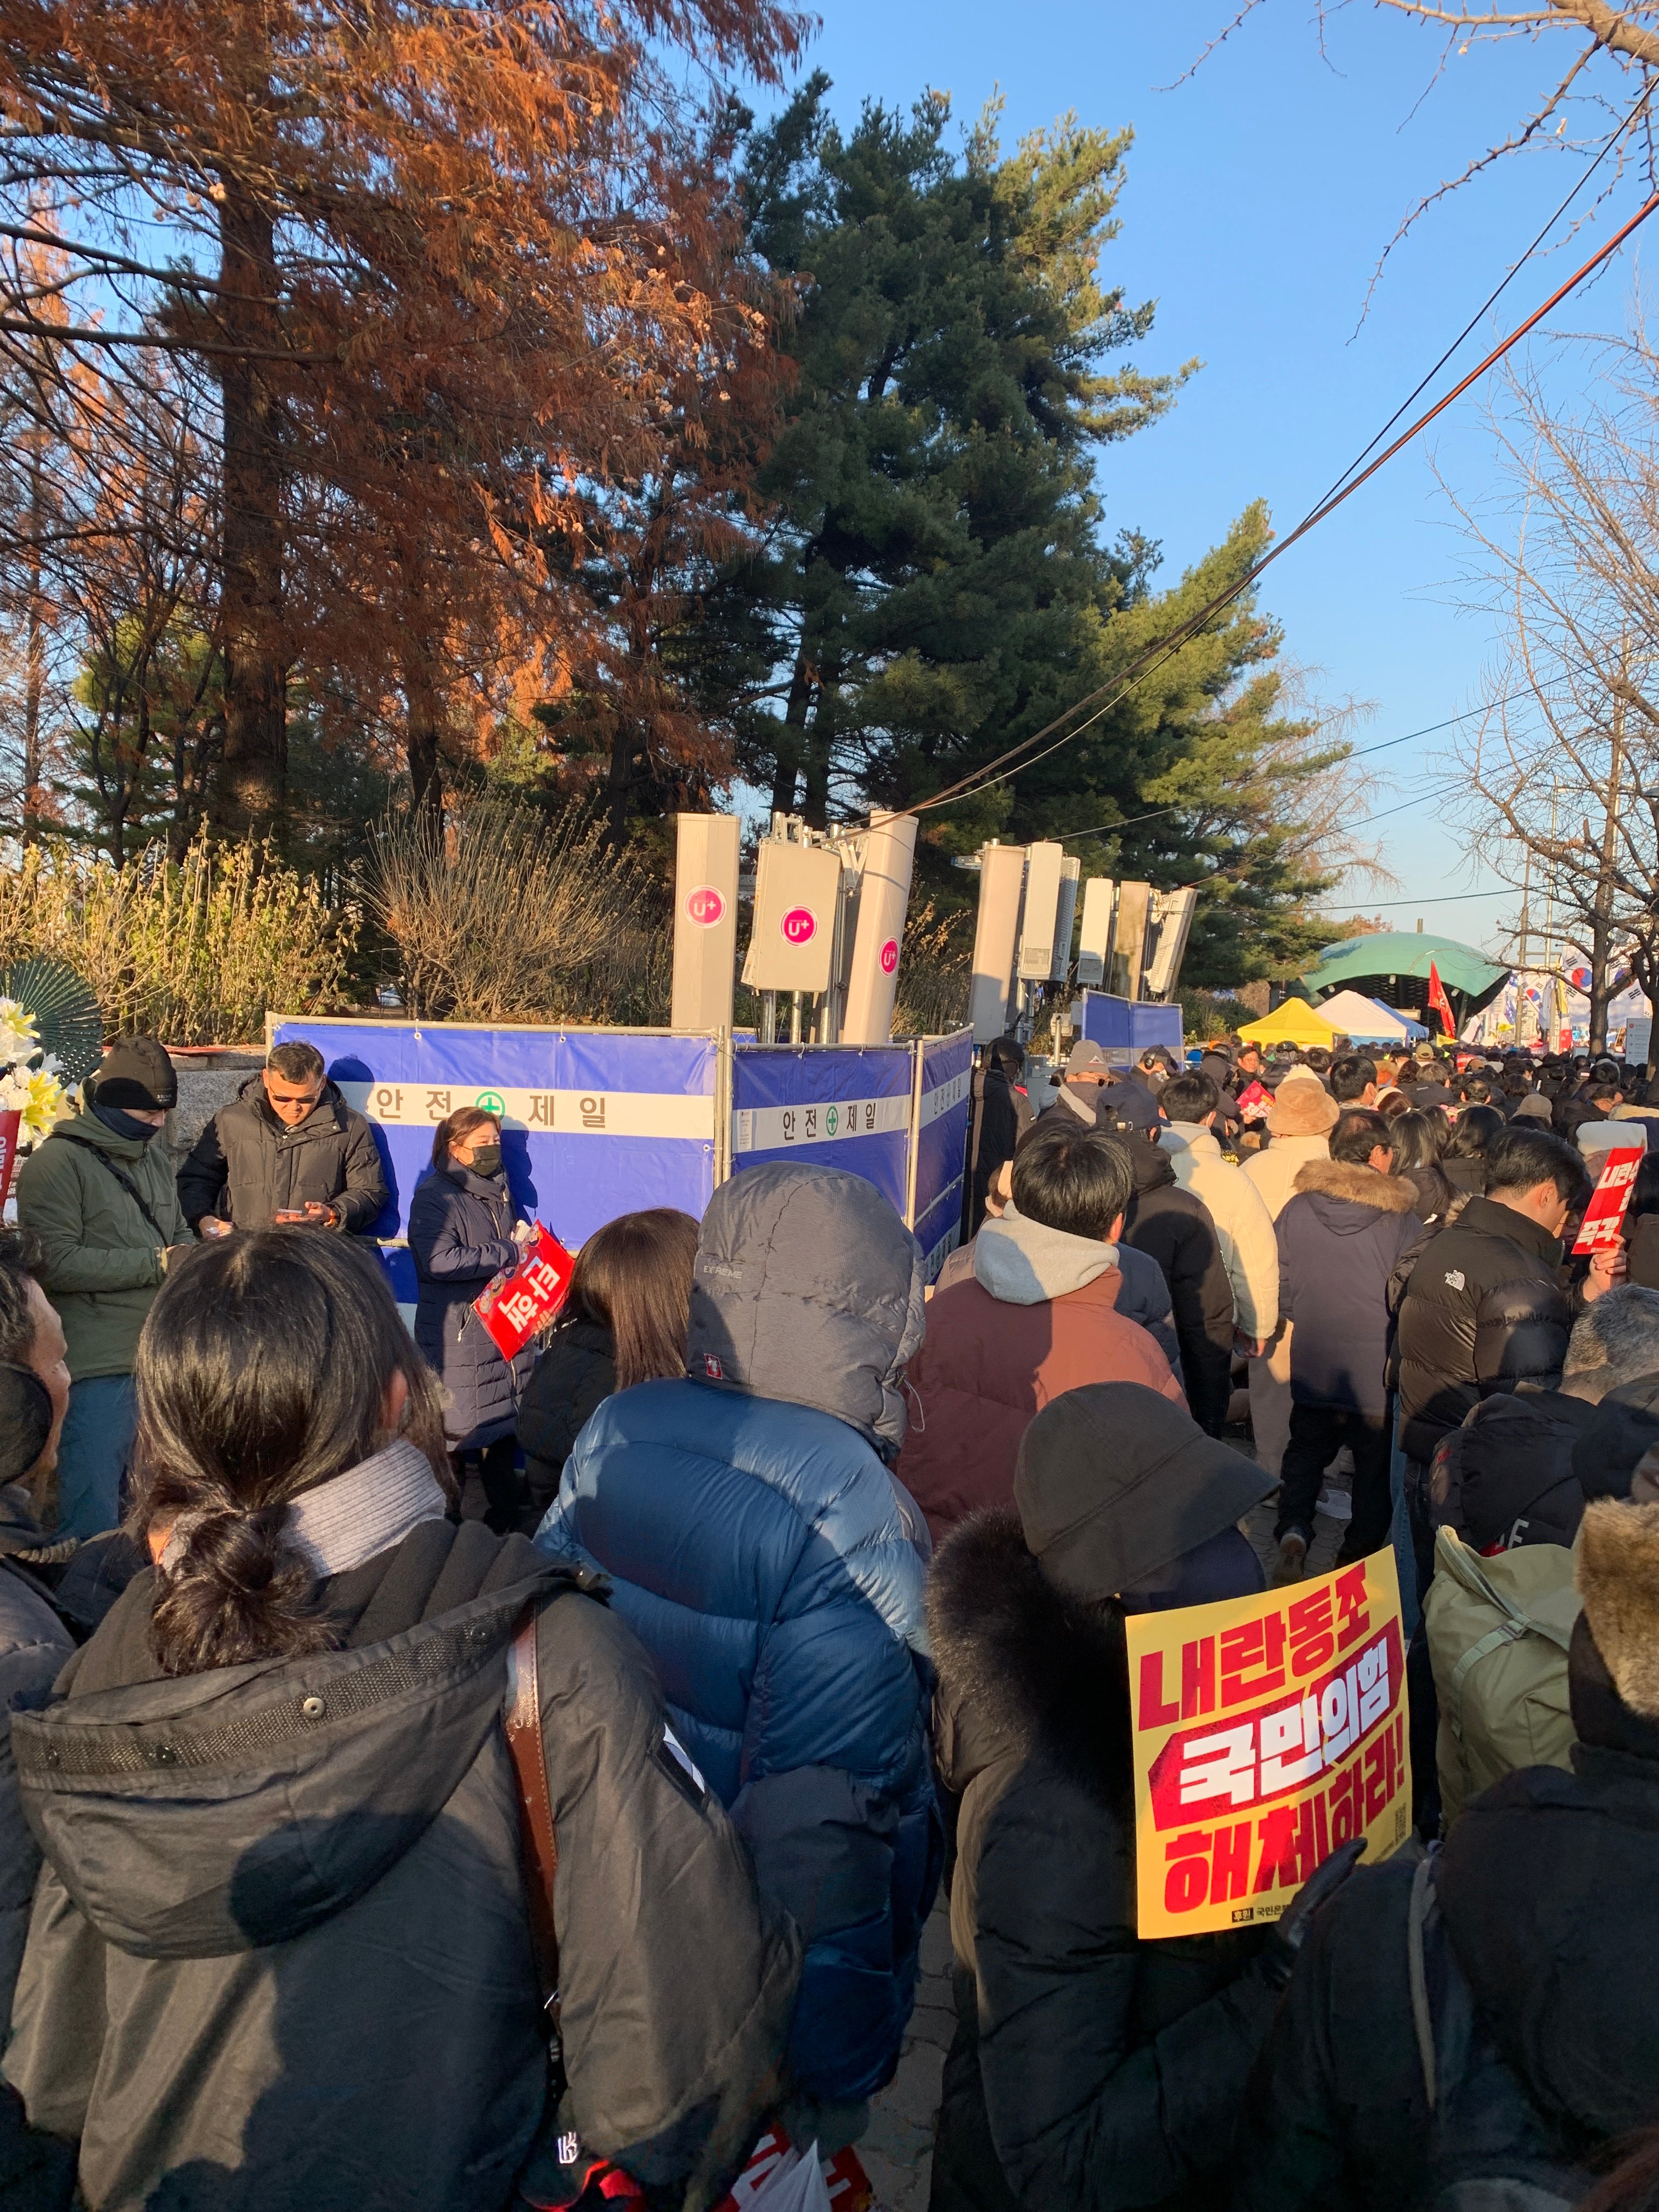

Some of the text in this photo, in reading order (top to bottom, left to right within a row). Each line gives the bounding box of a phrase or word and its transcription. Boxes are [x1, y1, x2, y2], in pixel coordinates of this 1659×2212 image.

[783, 1109, 817, 1141] 안전
[847, 1103, 876, 1132] 제일
[497, 1255, 561, 1334] 탄핵
[703, 1265, 743, 1279] EXTREME
[1138, 1561, 1370, 1731] 내란동조
[1180, 1636, 1390, 1806] 국민의힘
[1164, 1711, 1406, 1914] 해체하라!
